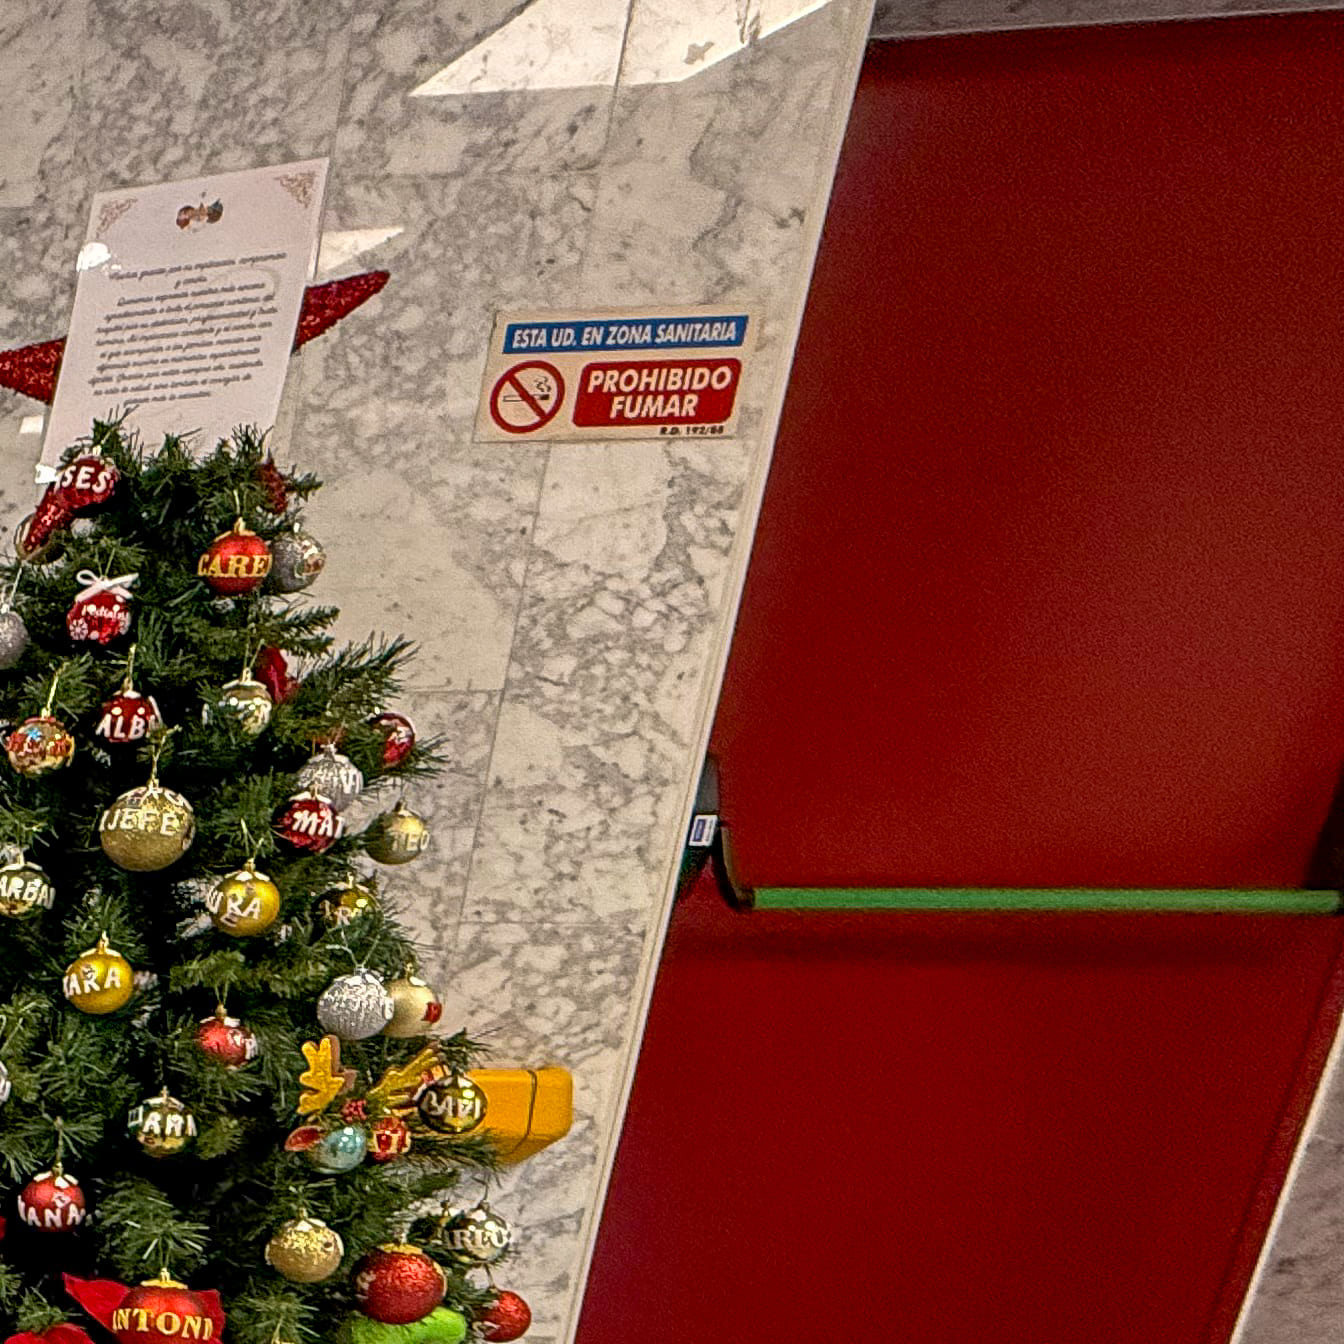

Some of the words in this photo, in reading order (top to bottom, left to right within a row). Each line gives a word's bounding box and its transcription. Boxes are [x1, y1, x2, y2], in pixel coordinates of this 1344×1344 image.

[511, 328, 547, 348] ESTA
[551, 328, 578, 347] UD.
[581, 326, 604, 345] EN
[605, 324, 652, 344] ZONA
[654, 321, 737, 343] SANITARIA
[587, 365, 732, 393] PROHIBIDO
[609, 394, 698, 419] FUMAR
